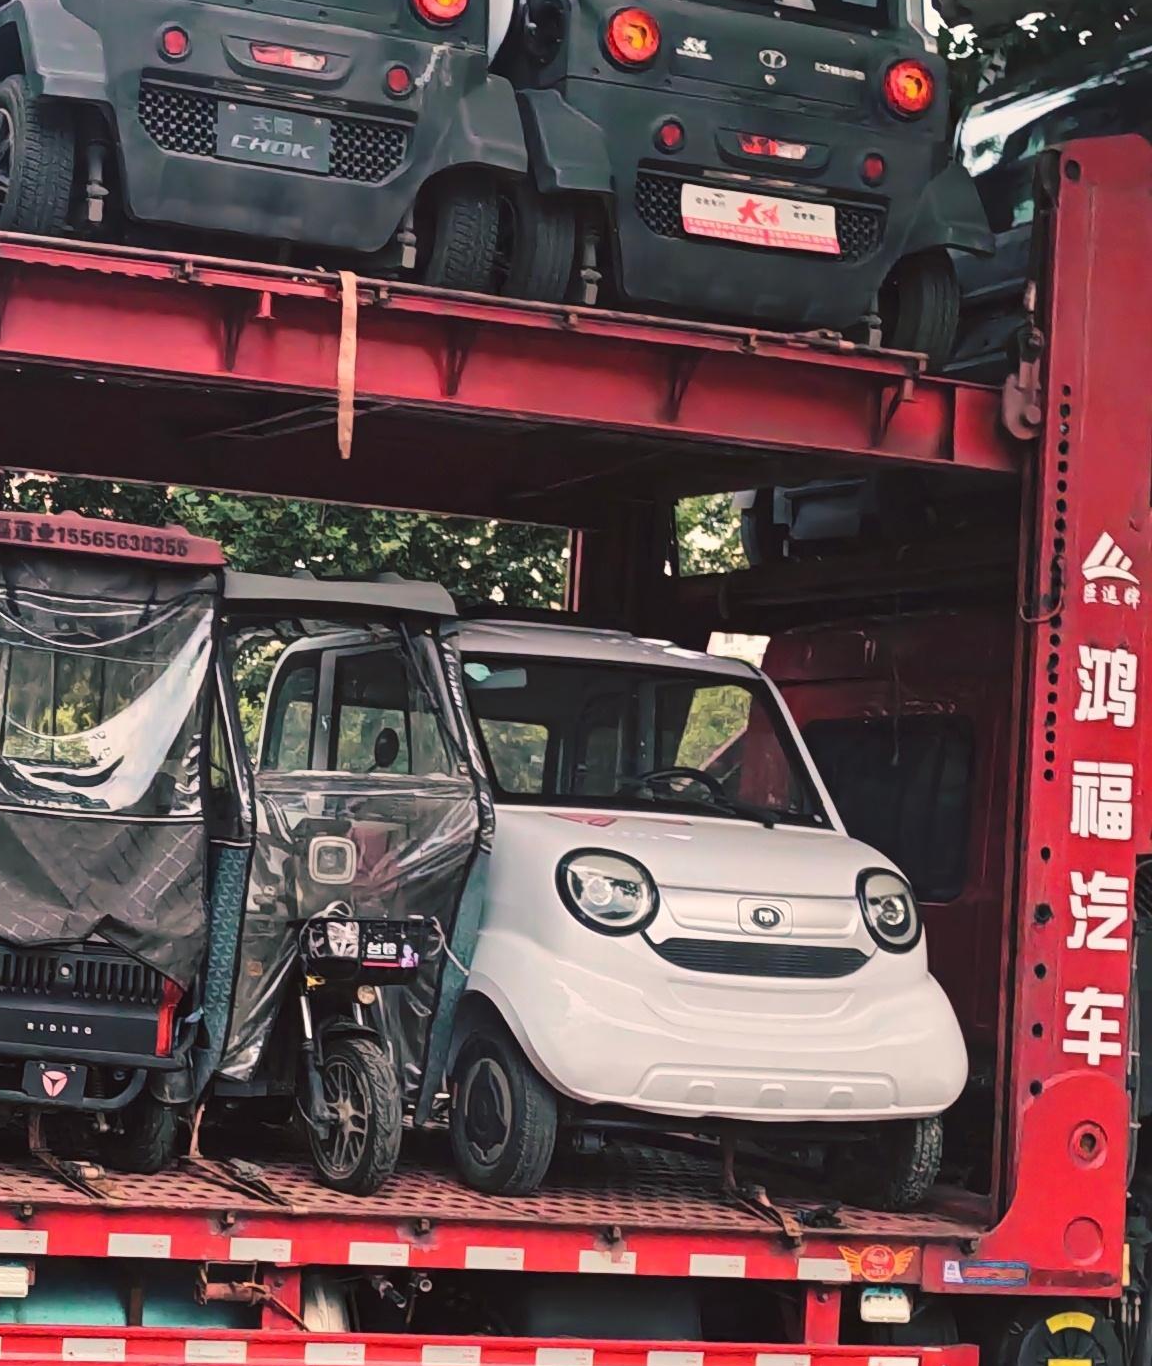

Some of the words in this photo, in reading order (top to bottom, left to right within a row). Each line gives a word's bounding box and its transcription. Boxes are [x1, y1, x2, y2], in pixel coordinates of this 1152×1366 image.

[230, 133, 315, 160] CHOK
[1062, 644, 1139, 1067] 鸿福汽车
[26, 1021, 93, 1036] RIDING
